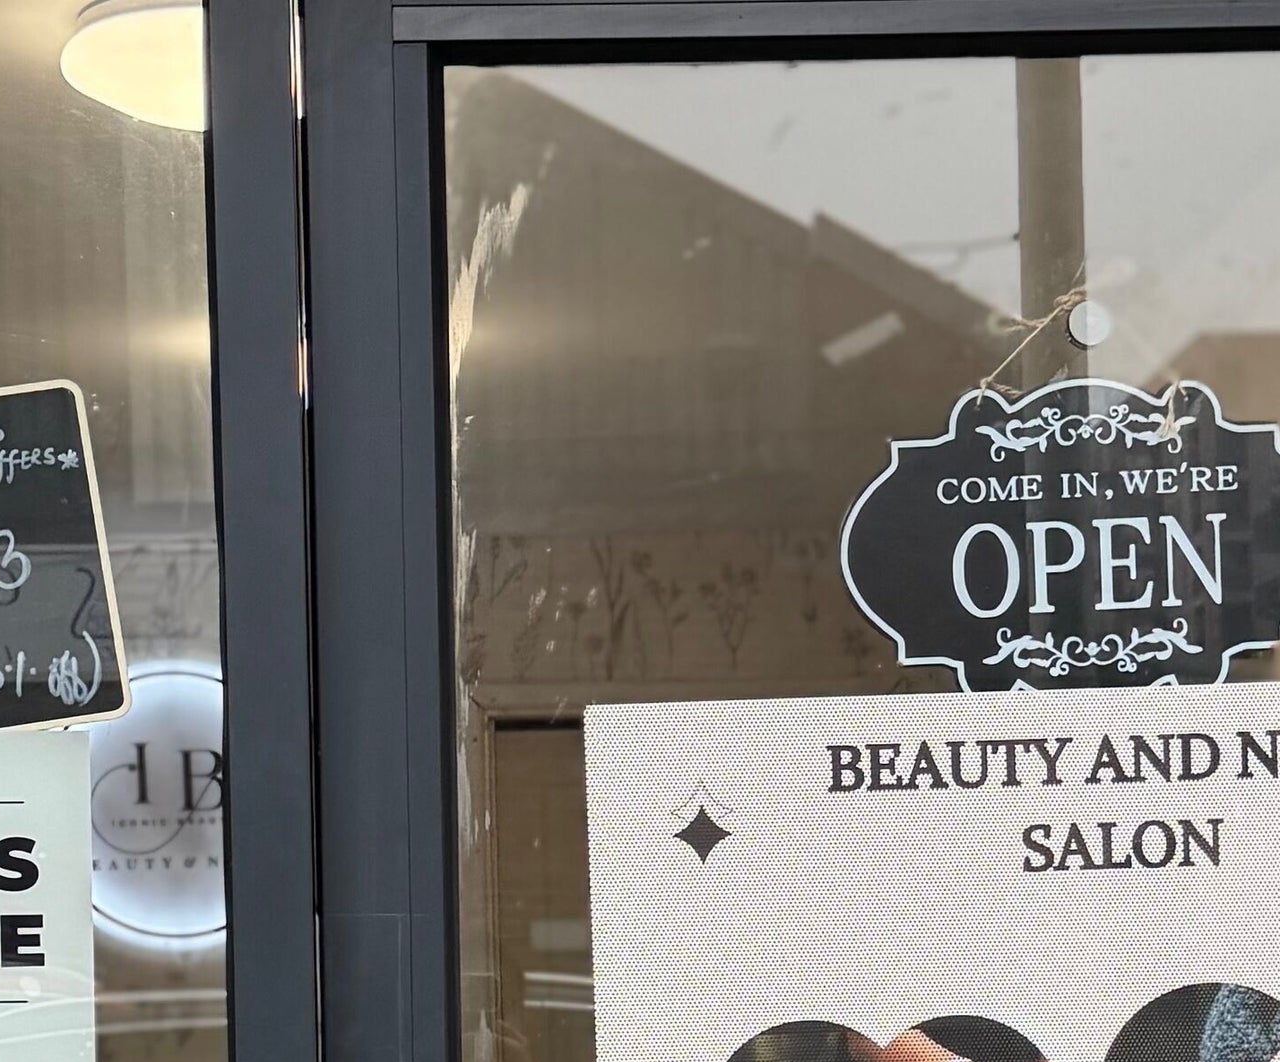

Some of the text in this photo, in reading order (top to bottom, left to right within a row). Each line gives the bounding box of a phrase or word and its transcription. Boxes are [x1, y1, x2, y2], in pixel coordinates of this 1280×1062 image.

[937, 463, 1239, 505] COME IN, WE'RE
[951, 512, 1227, 619] OPEN
[826, 737, 1073, 794] BEAUTY
[1085, 731, 1222, 786] AND
[93, 857, 171, 871] EAUTY
[1022, 817, 1225, 873] SALON
